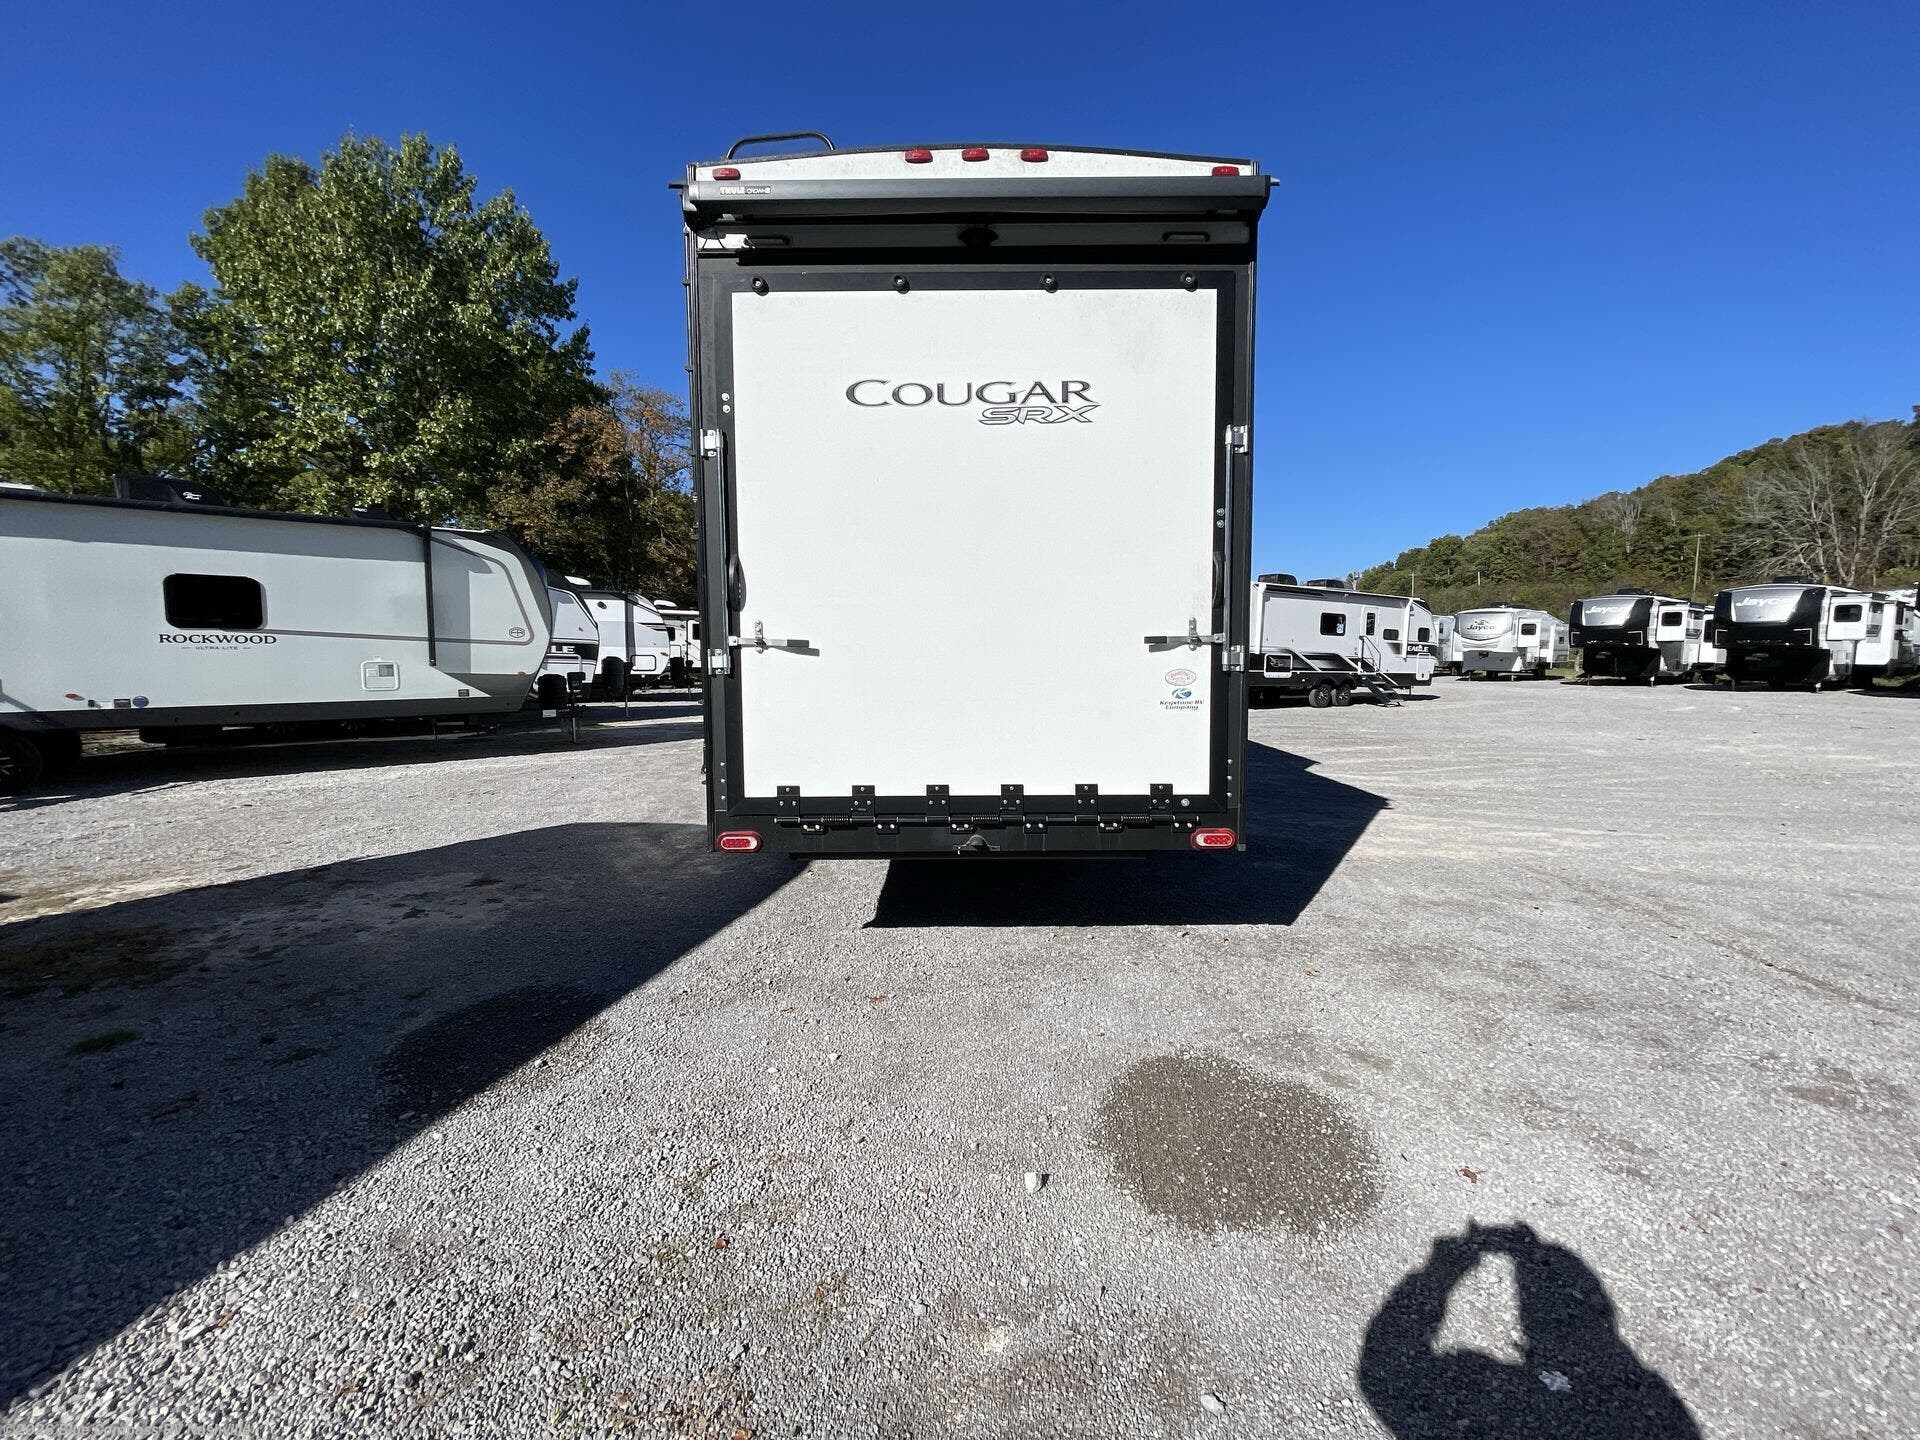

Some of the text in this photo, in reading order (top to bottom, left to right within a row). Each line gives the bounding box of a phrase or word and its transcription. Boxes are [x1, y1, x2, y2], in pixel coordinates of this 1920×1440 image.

[846, 379, 1099, 407] COUGAR
[978, 404, 1101, 426] SRX
[159, 634, 277, 645] ROCKWOOD
[550, 645, 575, 654] LE
